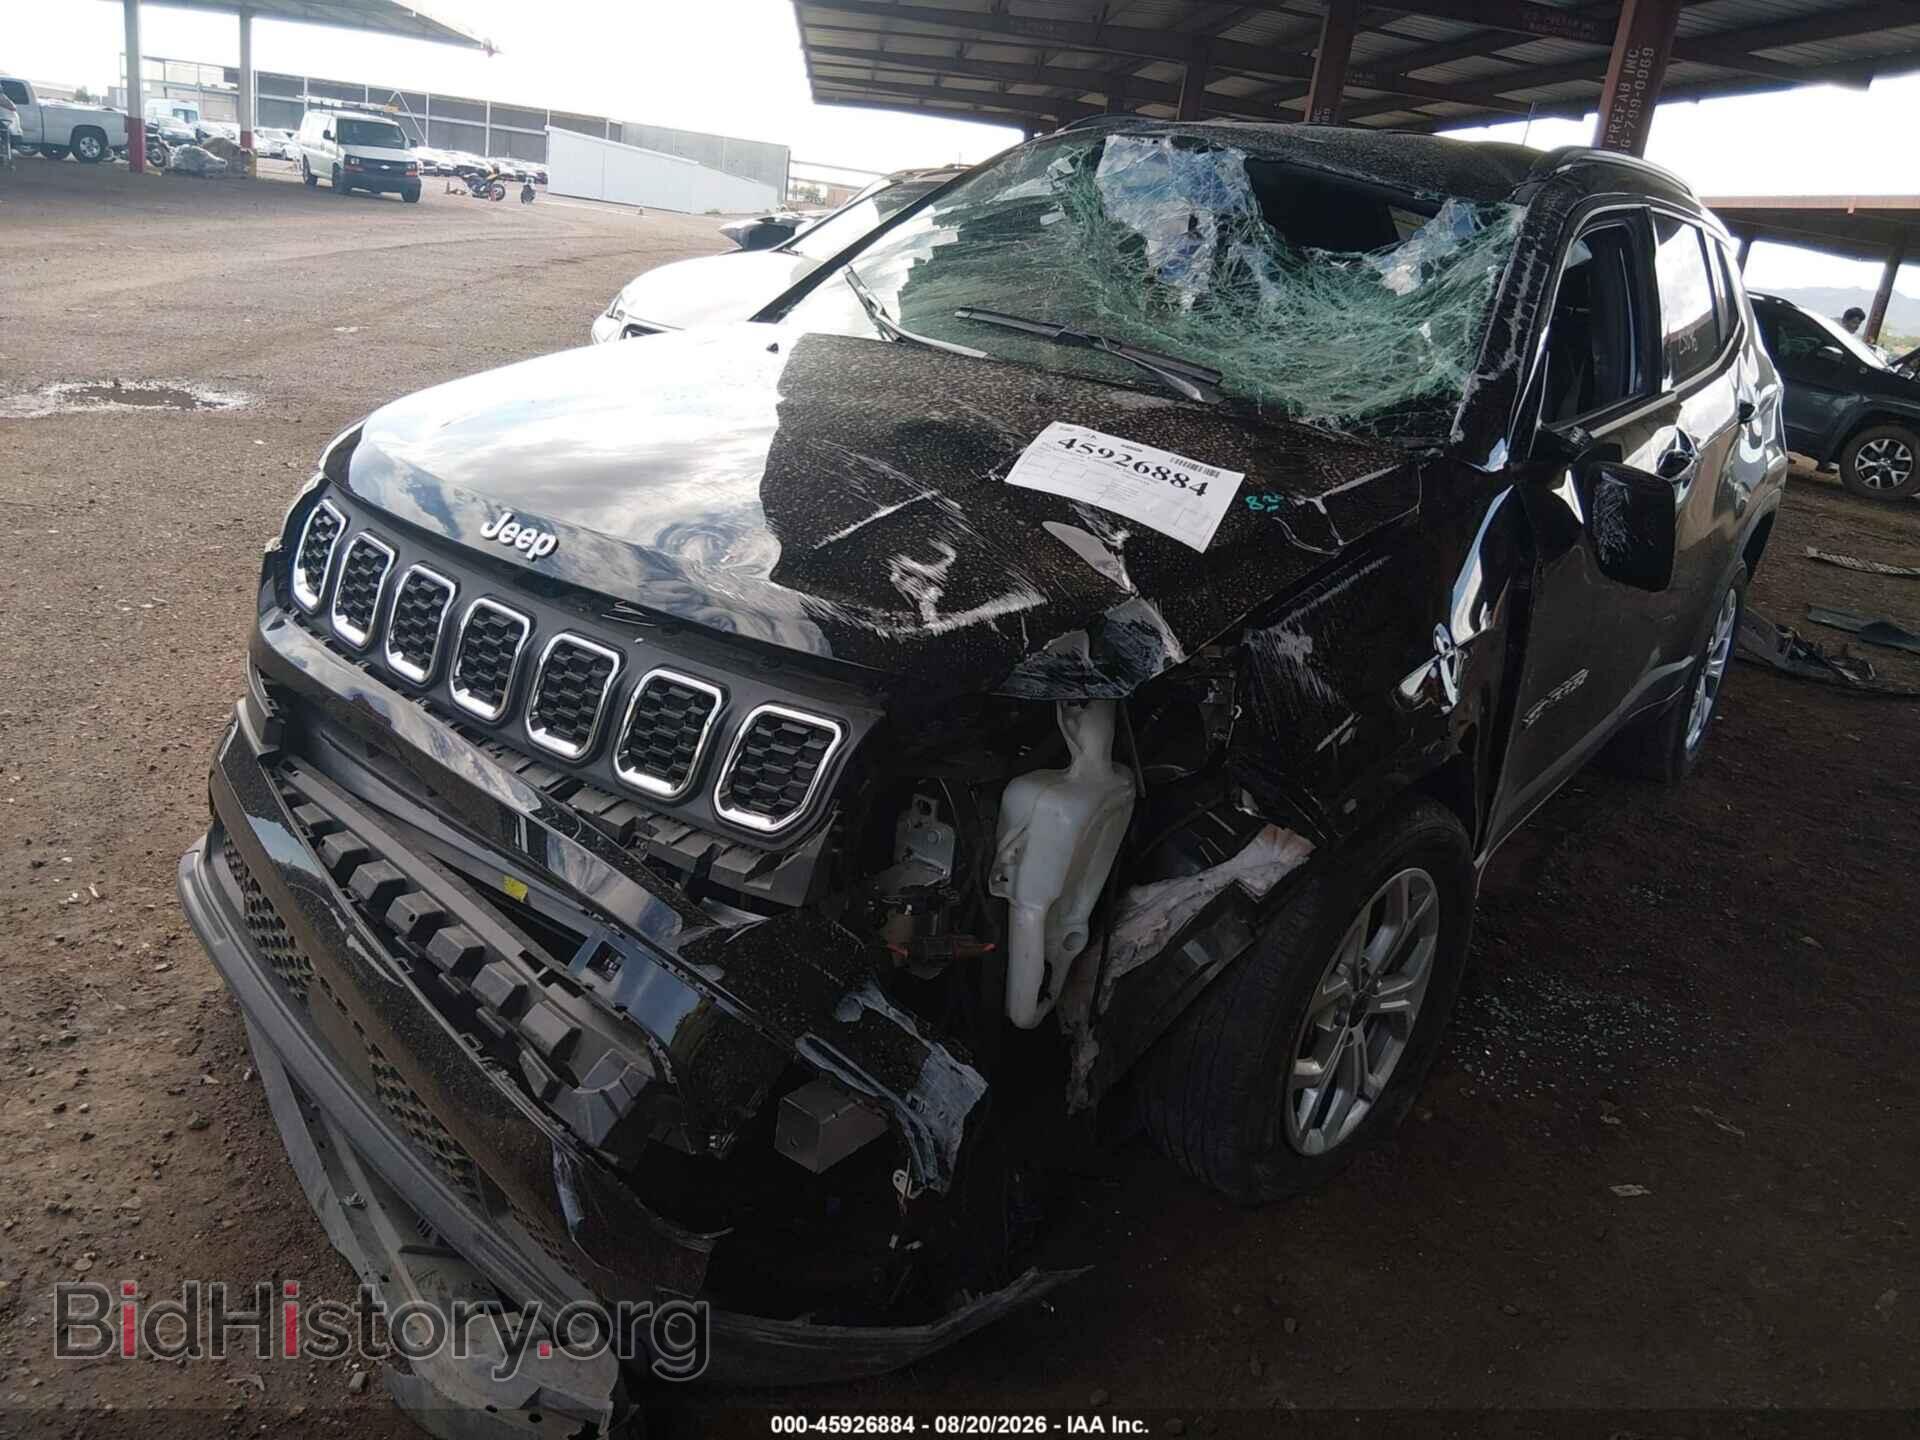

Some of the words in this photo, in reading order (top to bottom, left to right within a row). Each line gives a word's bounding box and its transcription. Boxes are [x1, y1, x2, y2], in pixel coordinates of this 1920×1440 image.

[1606, 82, 1632, 144] PREFAB
[1057, 437, 1210, 497] 45926884
[480, 511, 558, 560] Jeep
